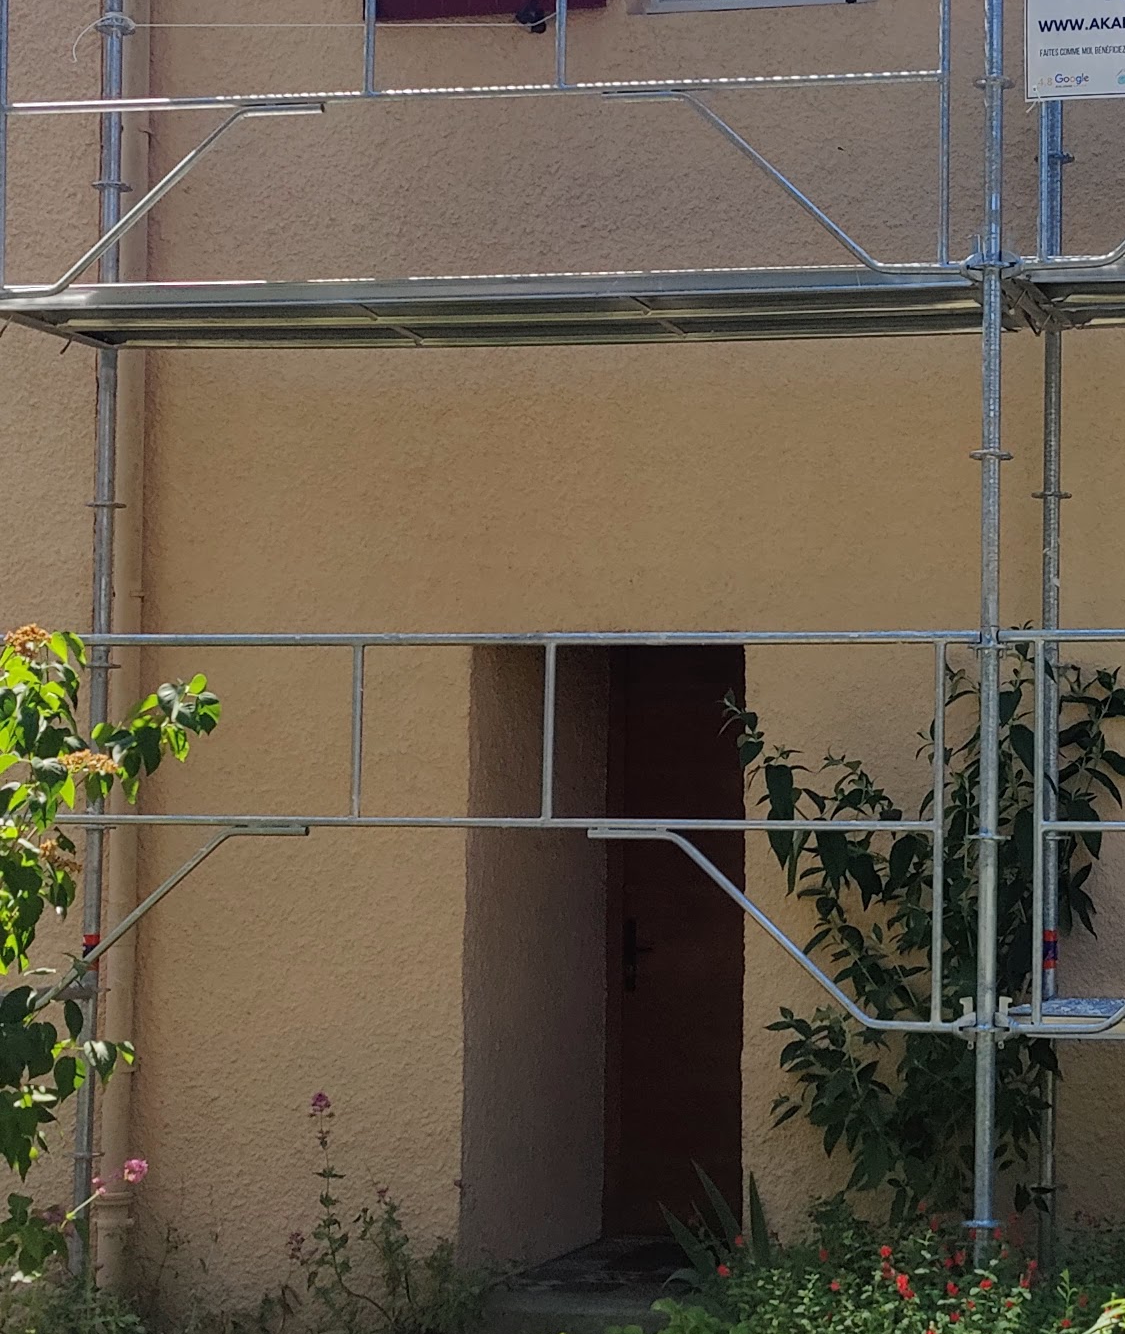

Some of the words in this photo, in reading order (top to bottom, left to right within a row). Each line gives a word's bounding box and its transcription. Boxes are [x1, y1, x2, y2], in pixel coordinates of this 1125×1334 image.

[1039, 48, 1059, 57] FAITES
[1060, 47, 1080, 56] COMME
[1094, 45, 1125, 55] BÉNÉFICIEZ
[1055, 73, 1089, 85] Google
